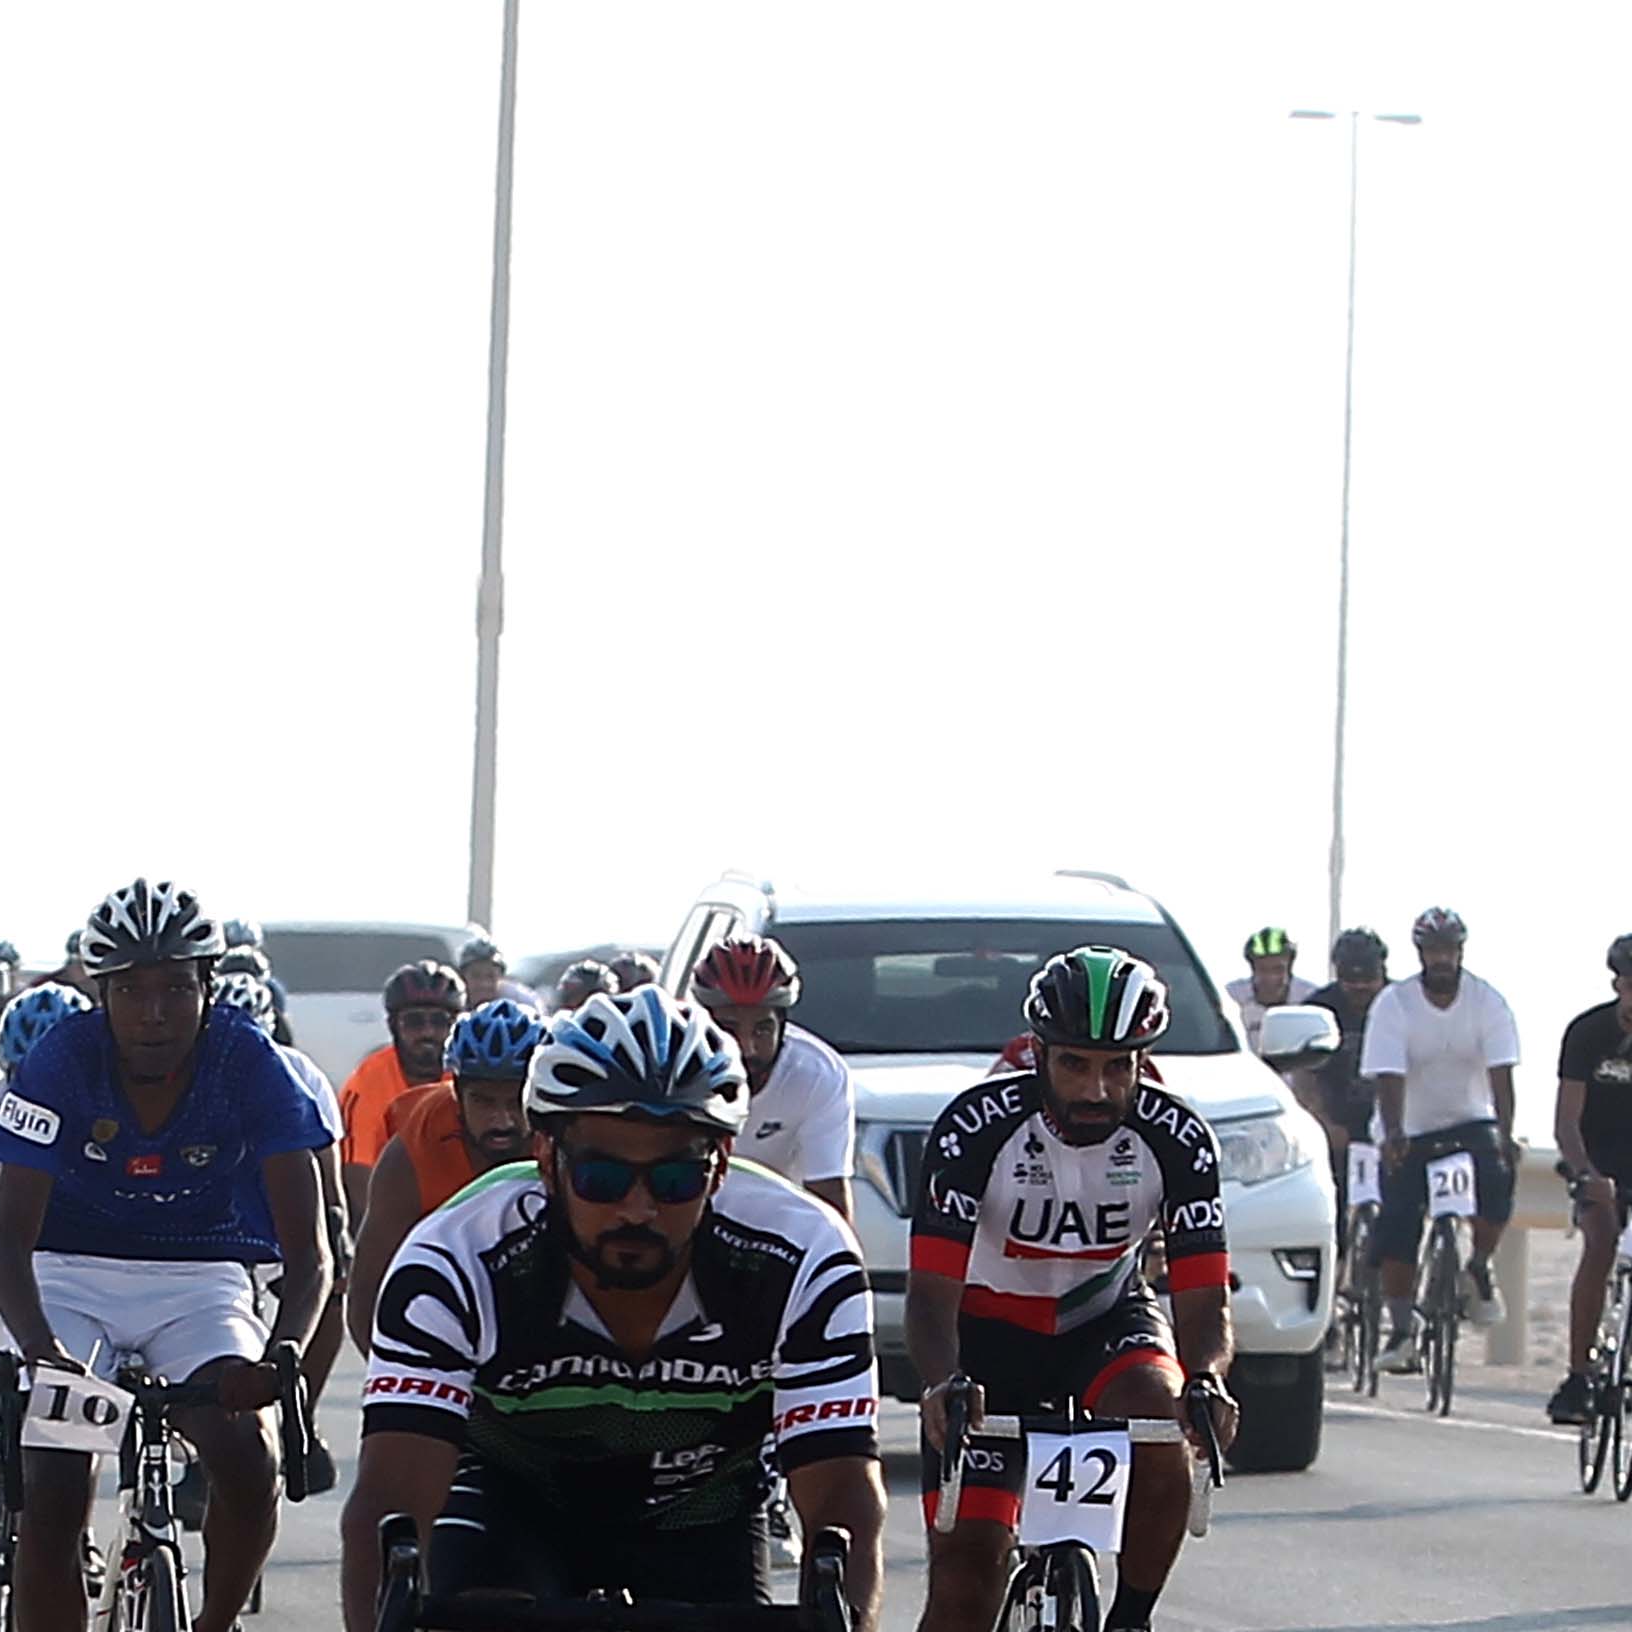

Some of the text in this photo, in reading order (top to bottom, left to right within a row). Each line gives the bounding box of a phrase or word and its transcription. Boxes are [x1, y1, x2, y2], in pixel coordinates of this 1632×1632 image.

[952, 1084, 1023, 1134] UAE
[1137, 1090, 1205, 1147] UAE
[941, 1189, 980, 1222] AD
[1433, 1167, 1469, 1198] 20
[1009, 1198, 1131, 1245] UAE
[38, 1384, 120, 1426] 10
[1035, 1446, 1118, 1504] 42
